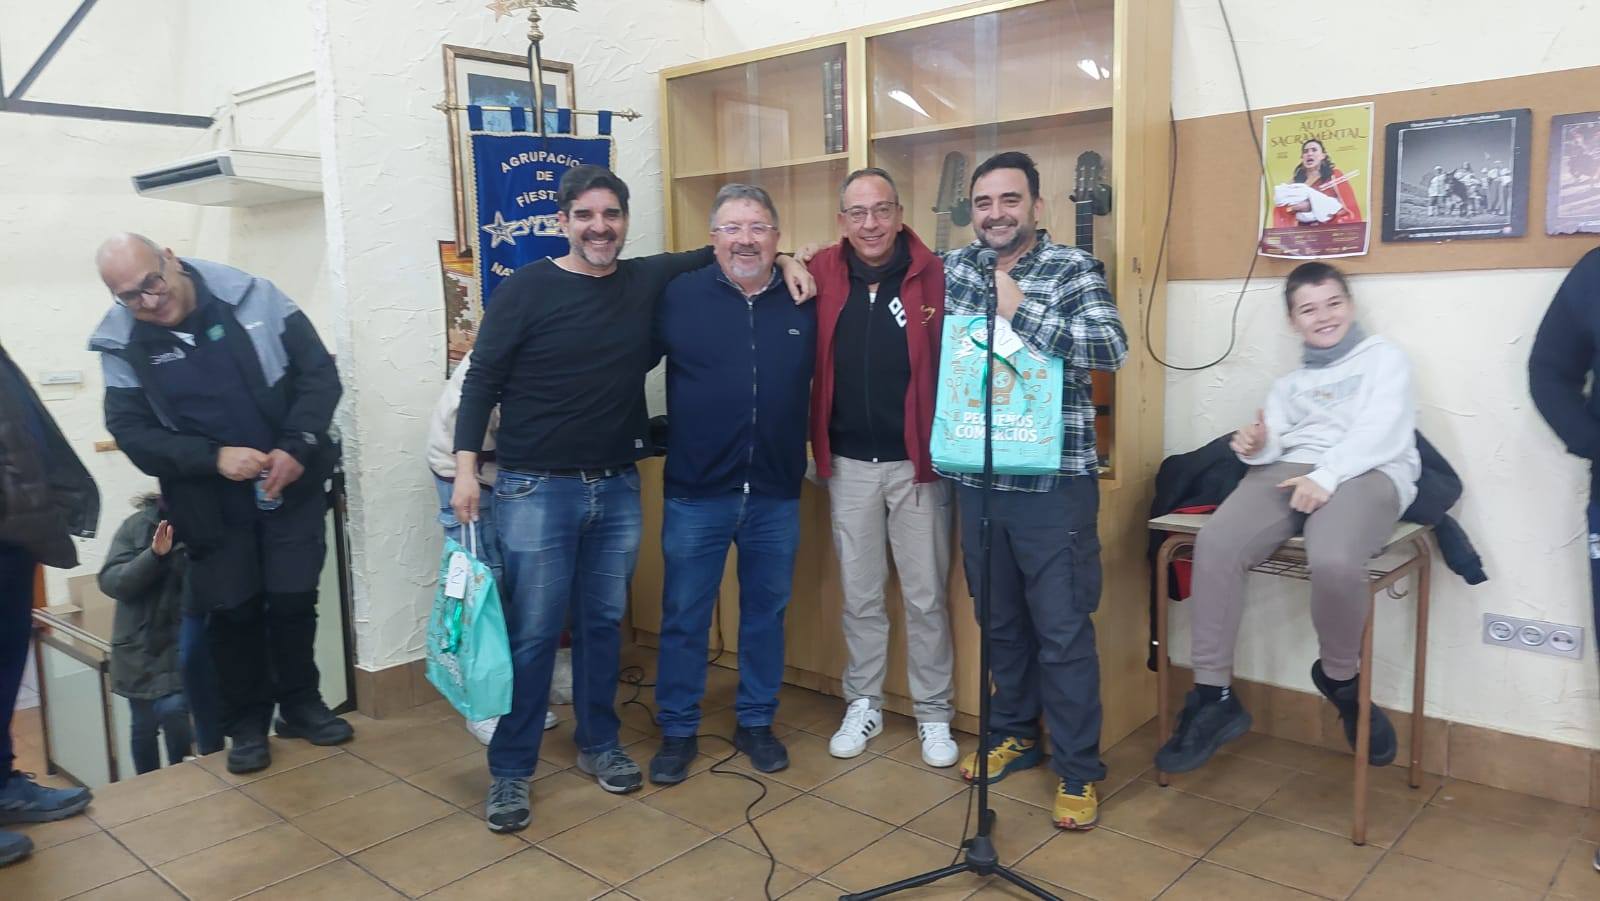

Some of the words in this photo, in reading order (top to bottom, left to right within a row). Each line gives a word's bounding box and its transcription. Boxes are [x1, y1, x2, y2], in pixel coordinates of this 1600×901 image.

[1301, 118, 1336, 131] AUTO
[1271, 128, 1368, 147] SACRAMENTAL
[536, 170, 555, 181] DE
[515, 189, 559, 208] FIEST
